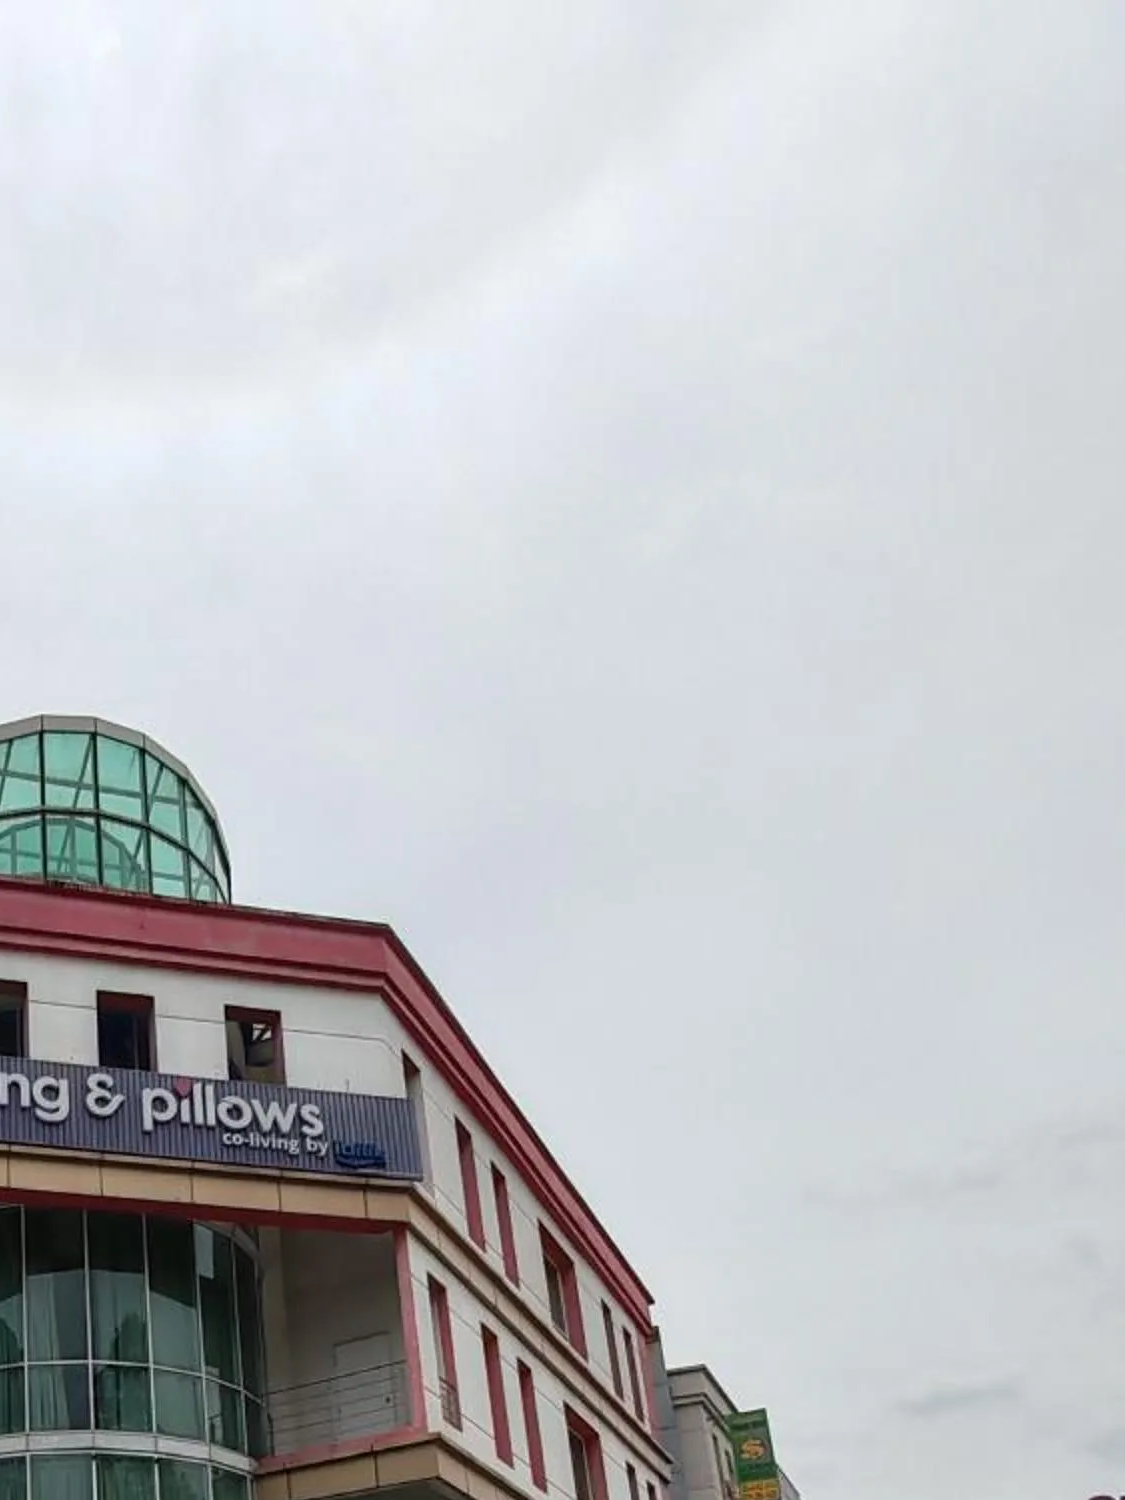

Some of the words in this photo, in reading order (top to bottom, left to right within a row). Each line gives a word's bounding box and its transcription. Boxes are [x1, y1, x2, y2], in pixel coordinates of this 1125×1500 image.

[85, 1072, 125, 1118] &
[141, 1077, 326, 1139] pillows
[222, 1131, 301, 1156] co-living
[306, 1135, 330, 1158] by
